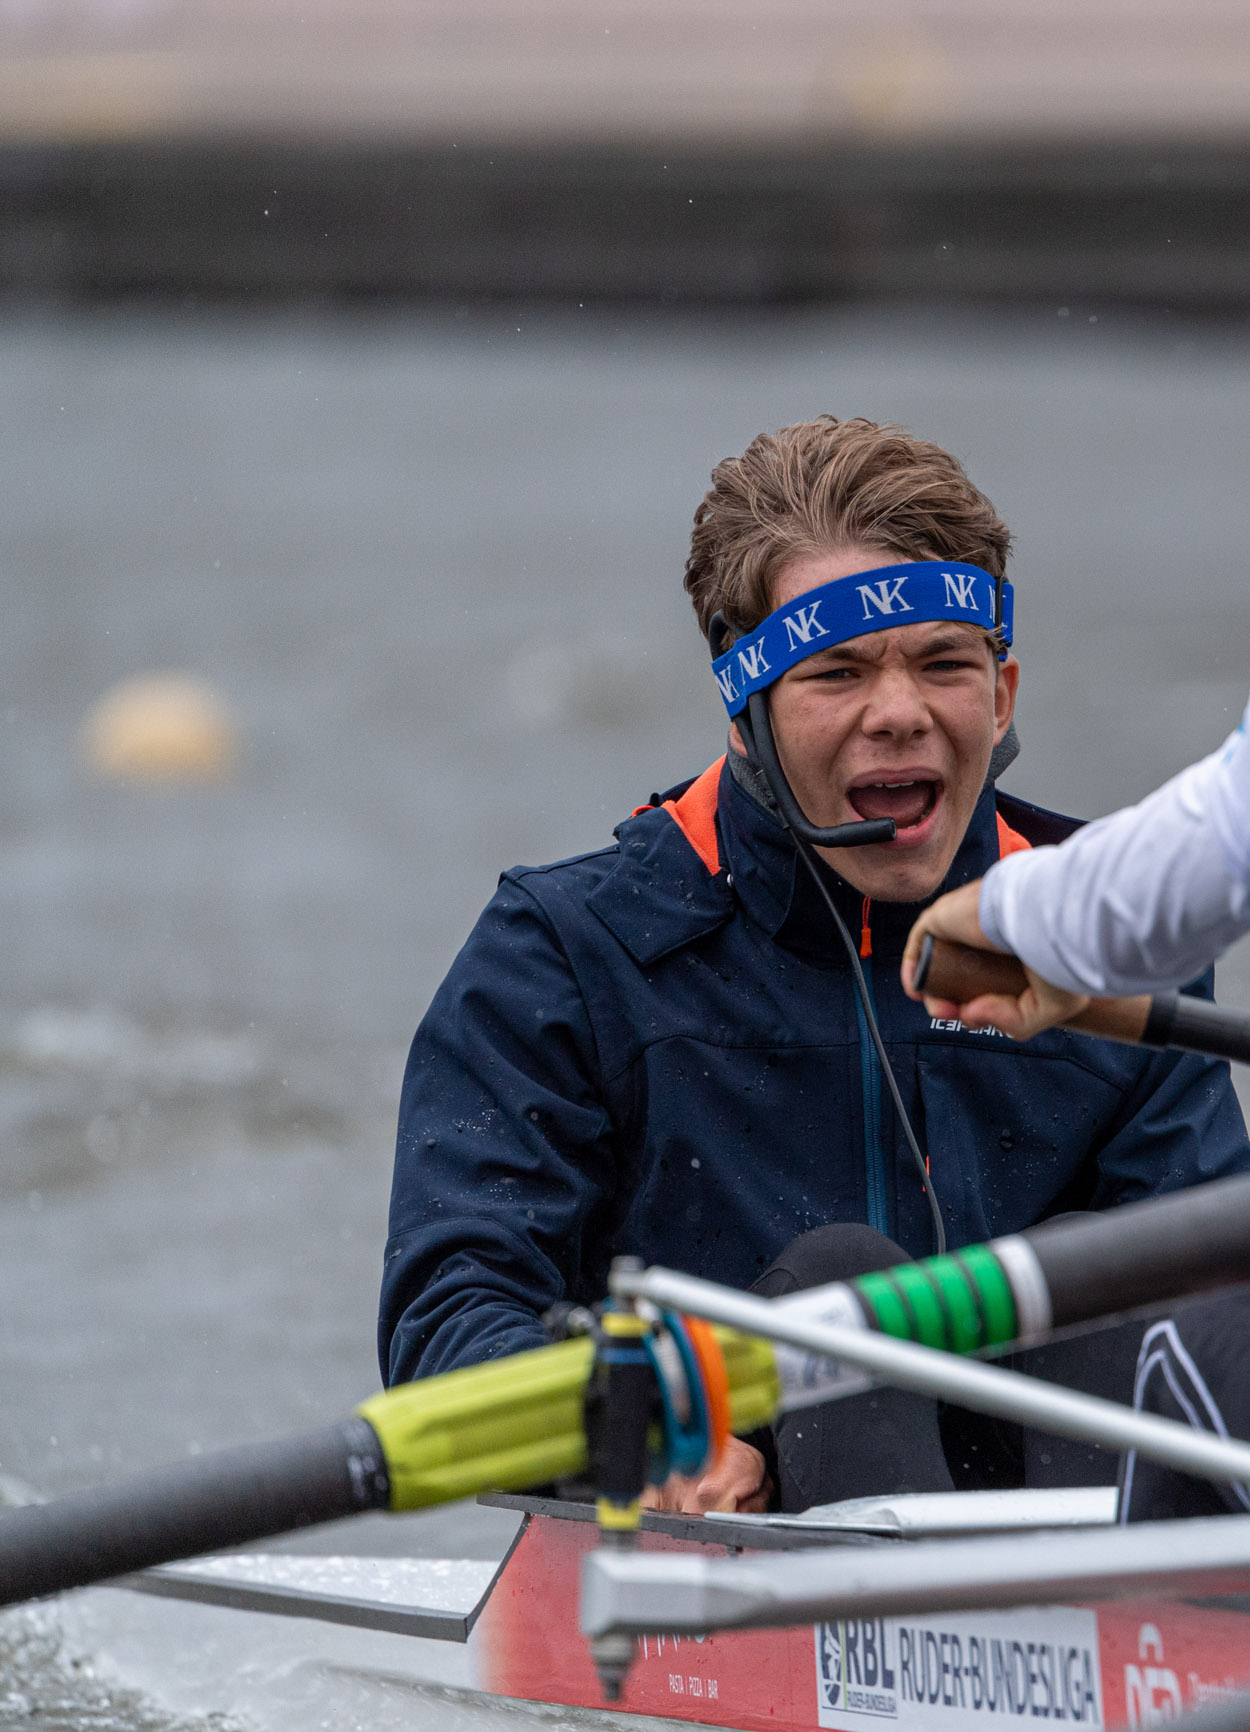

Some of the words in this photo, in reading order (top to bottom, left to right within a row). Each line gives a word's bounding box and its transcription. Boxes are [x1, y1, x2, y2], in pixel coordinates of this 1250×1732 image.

[715, 664, 740, 703] NK
[737, 636, 772, 686] NK
[782, 600, 830, 652] NK
[855, 576, 914, 620] NK
[940, 573, 979, 611] NK
[669, 1674, 684, 1694] PASTA
[689, 1676, 703, 1697] PIZZA
[708, 1679, 718, 1699] BAR
[846, 1618, 895, 1688] RBL
[899, 1627, 1099, 1724] RUDER-BUNDESLIGA
